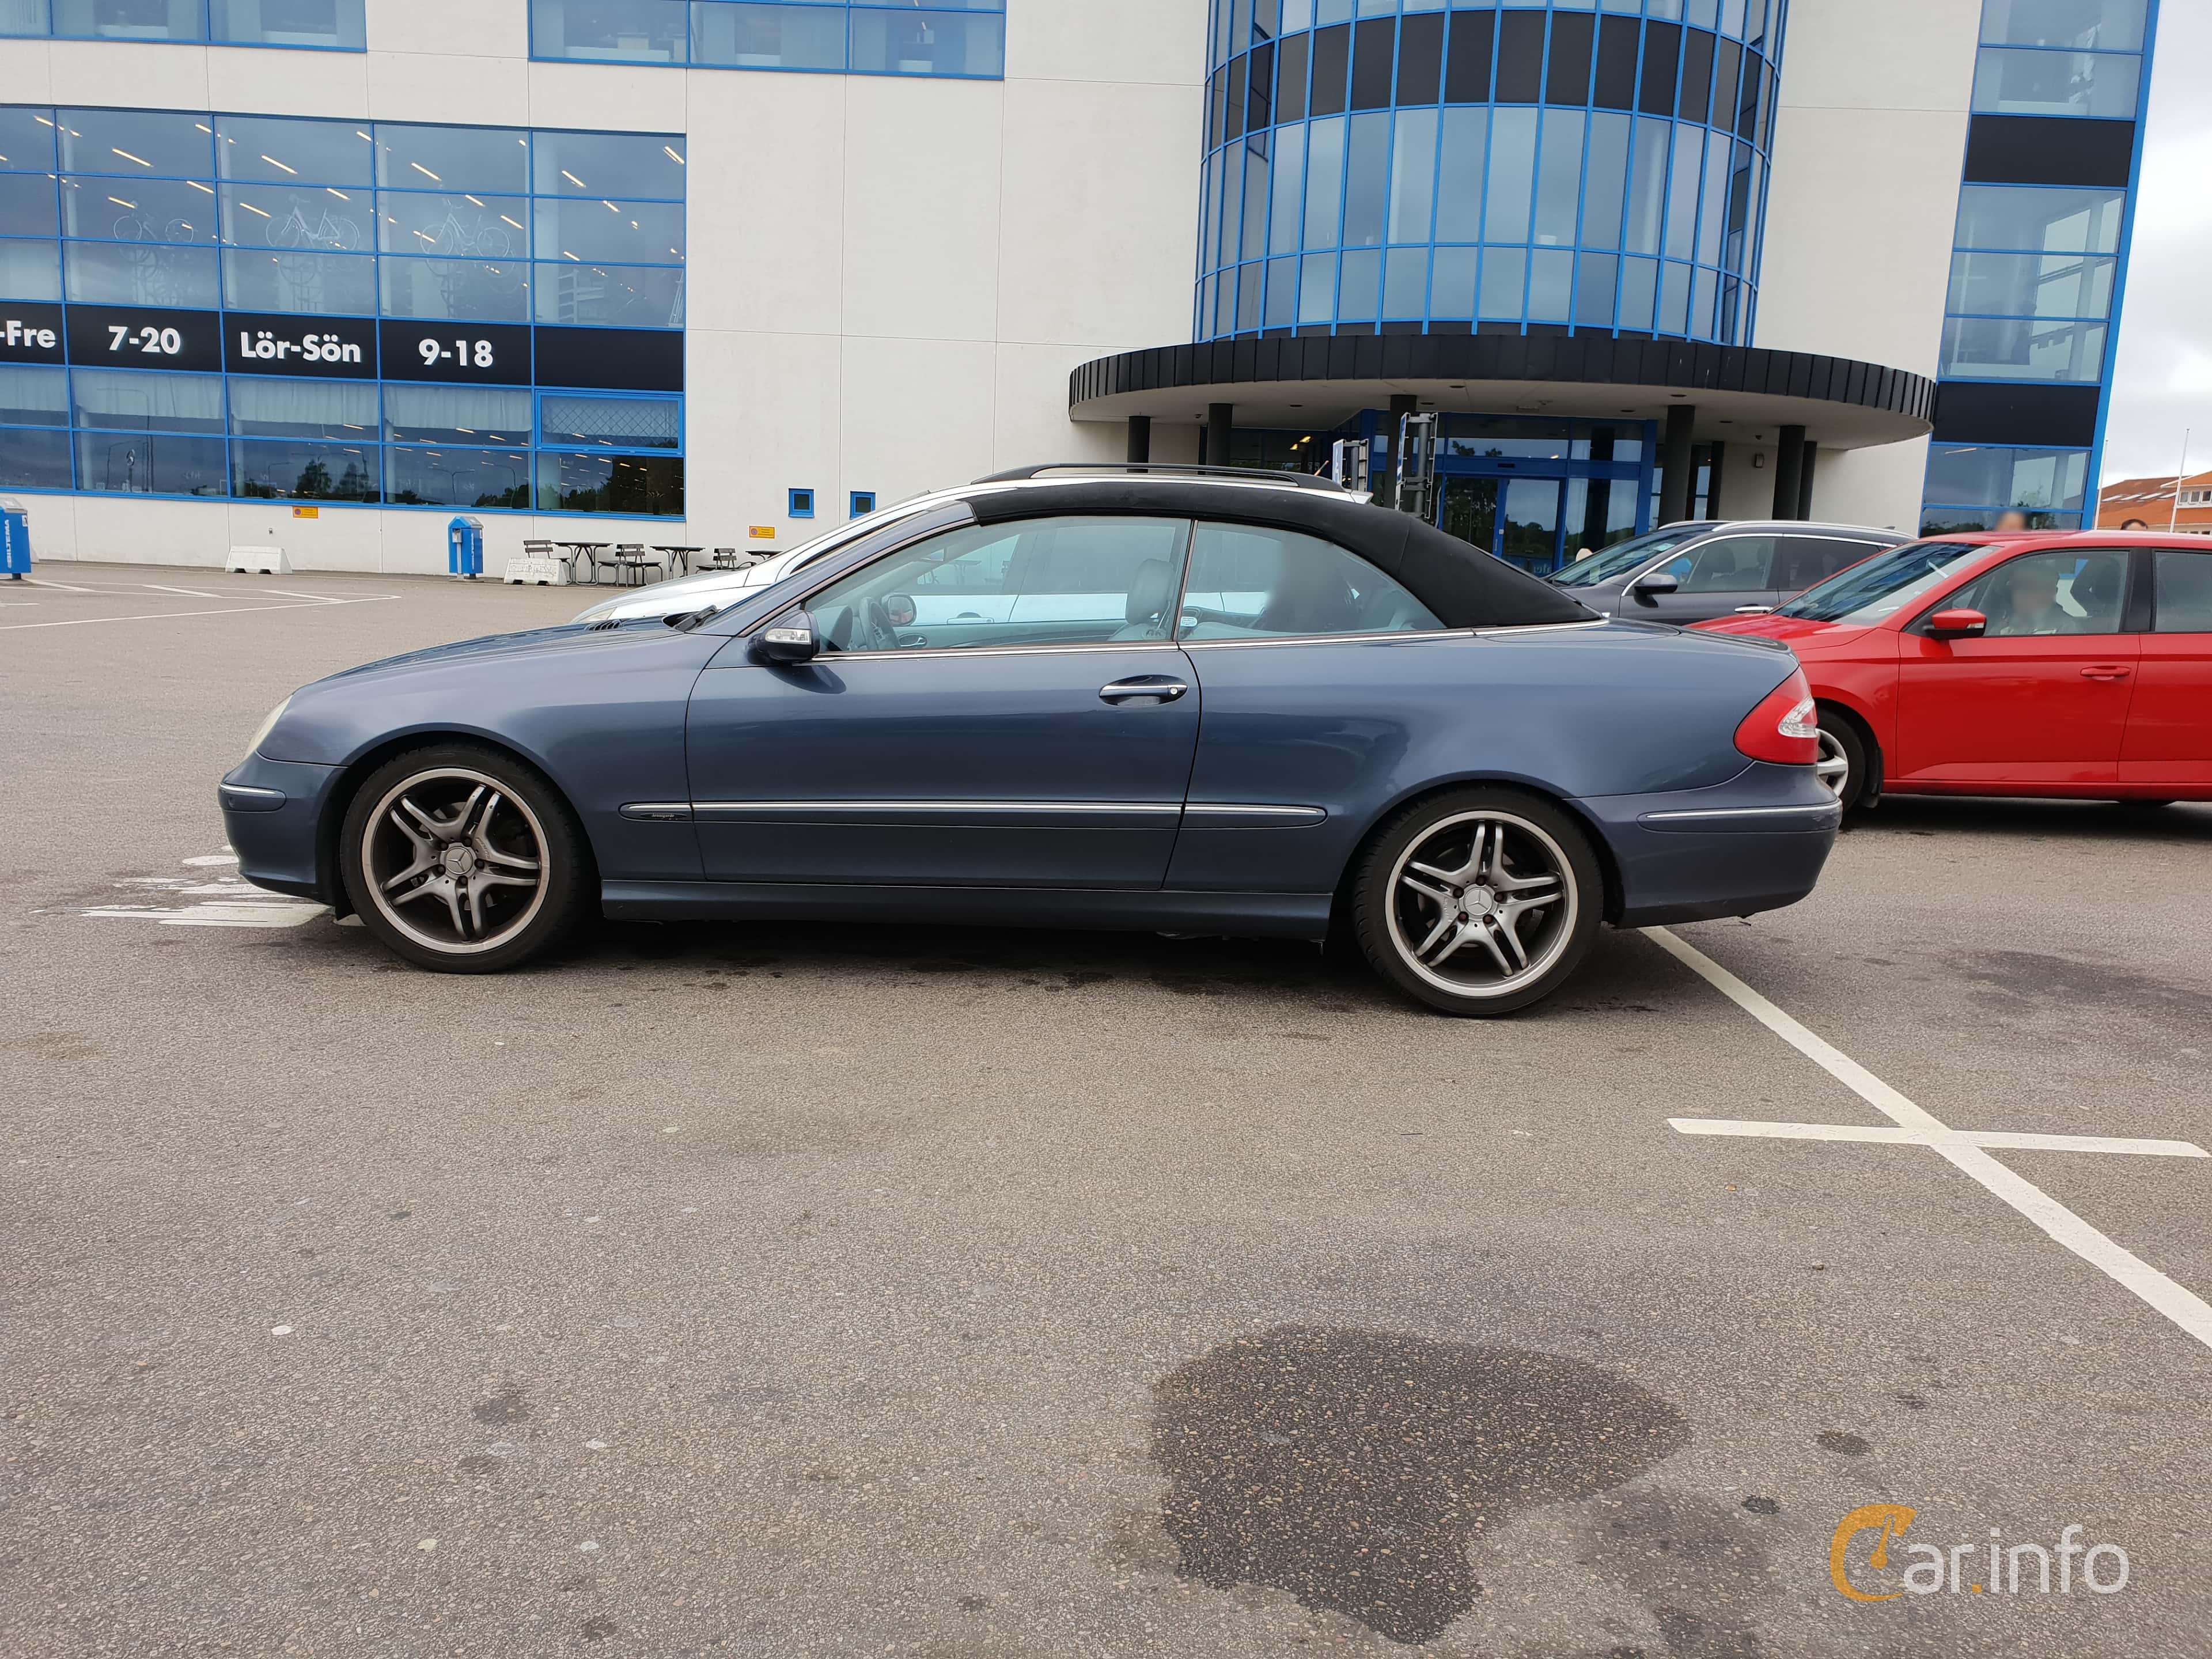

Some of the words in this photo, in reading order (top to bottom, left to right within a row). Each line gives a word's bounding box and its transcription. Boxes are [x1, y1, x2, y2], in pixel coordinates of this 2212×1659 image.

[108, 325, 181, 354] 7-20
[240, 331, 361, 363] Lör-Sön
[418, 338, 494, 368] 9-18
